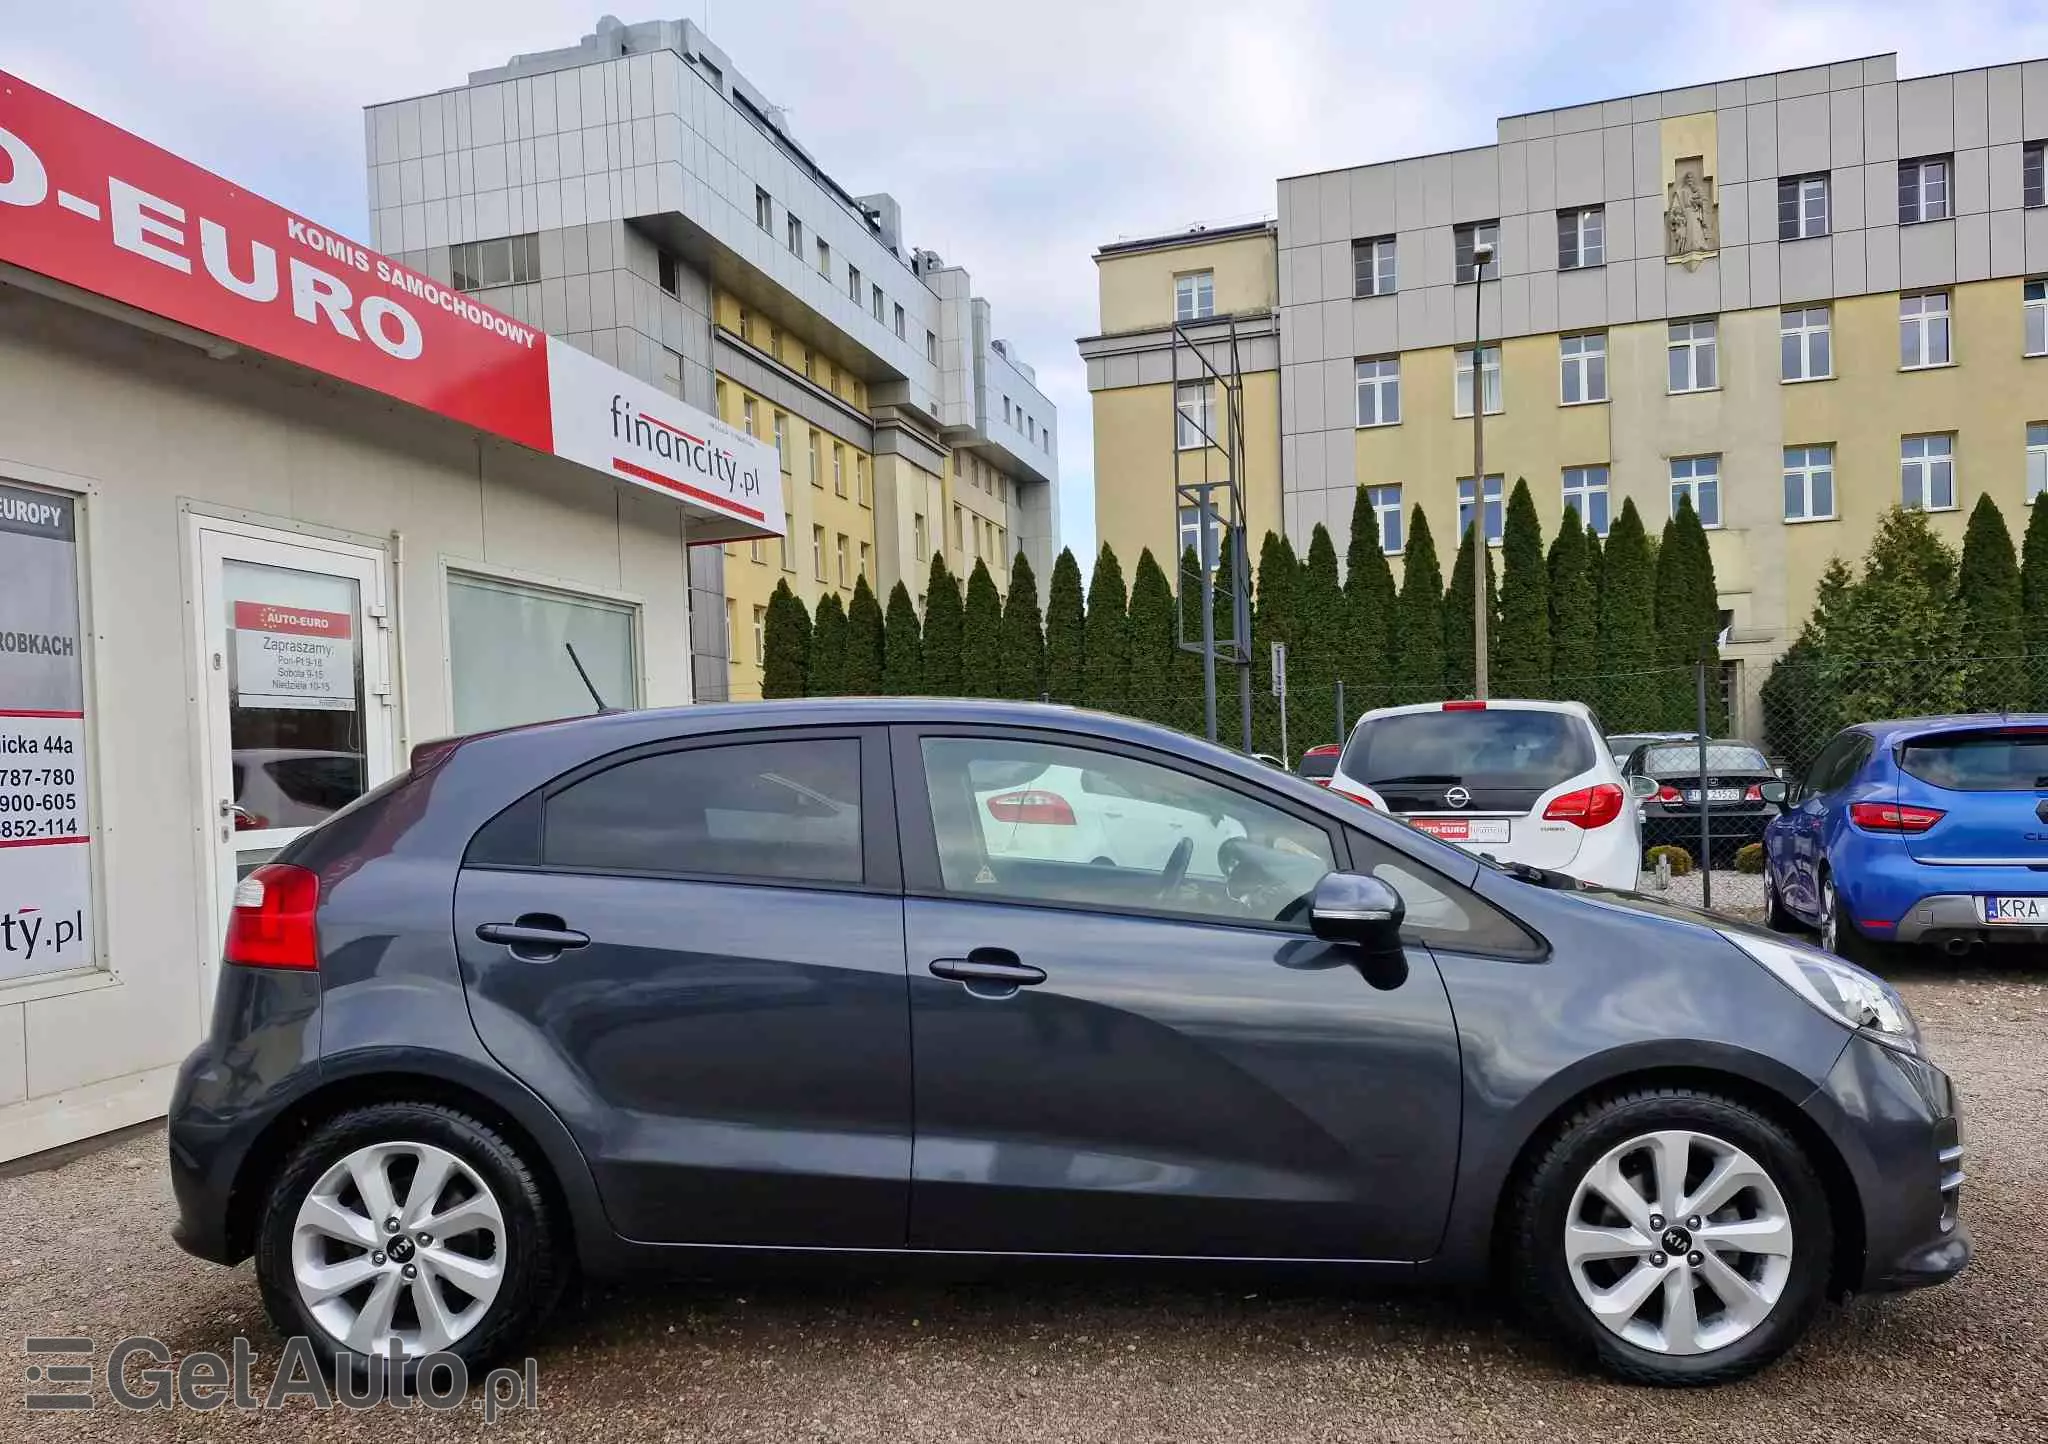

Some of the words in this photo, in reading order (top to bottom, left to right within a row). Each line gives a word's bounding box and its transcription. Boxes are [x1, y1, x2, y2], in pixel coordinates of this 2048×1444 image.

[288, 217, 370, 272] KOMIS
[377, 261, 536, 348] SAMOCHODOWY
[611, 395, 760, 497] financity.pl
[0, 499, 61, 527] UROPY
[267, 613, 329, 629] AUTO-EURO
[0, 735, 38, 754] icka
[44, 735, 73, 753] 44a
[0, 768, 75, 787] 787-780
[0, 793, 76, 812] 900-605
[1999, 899, 2040, 918] KRA
[1665, 1231, 1688, 1252] KIA
